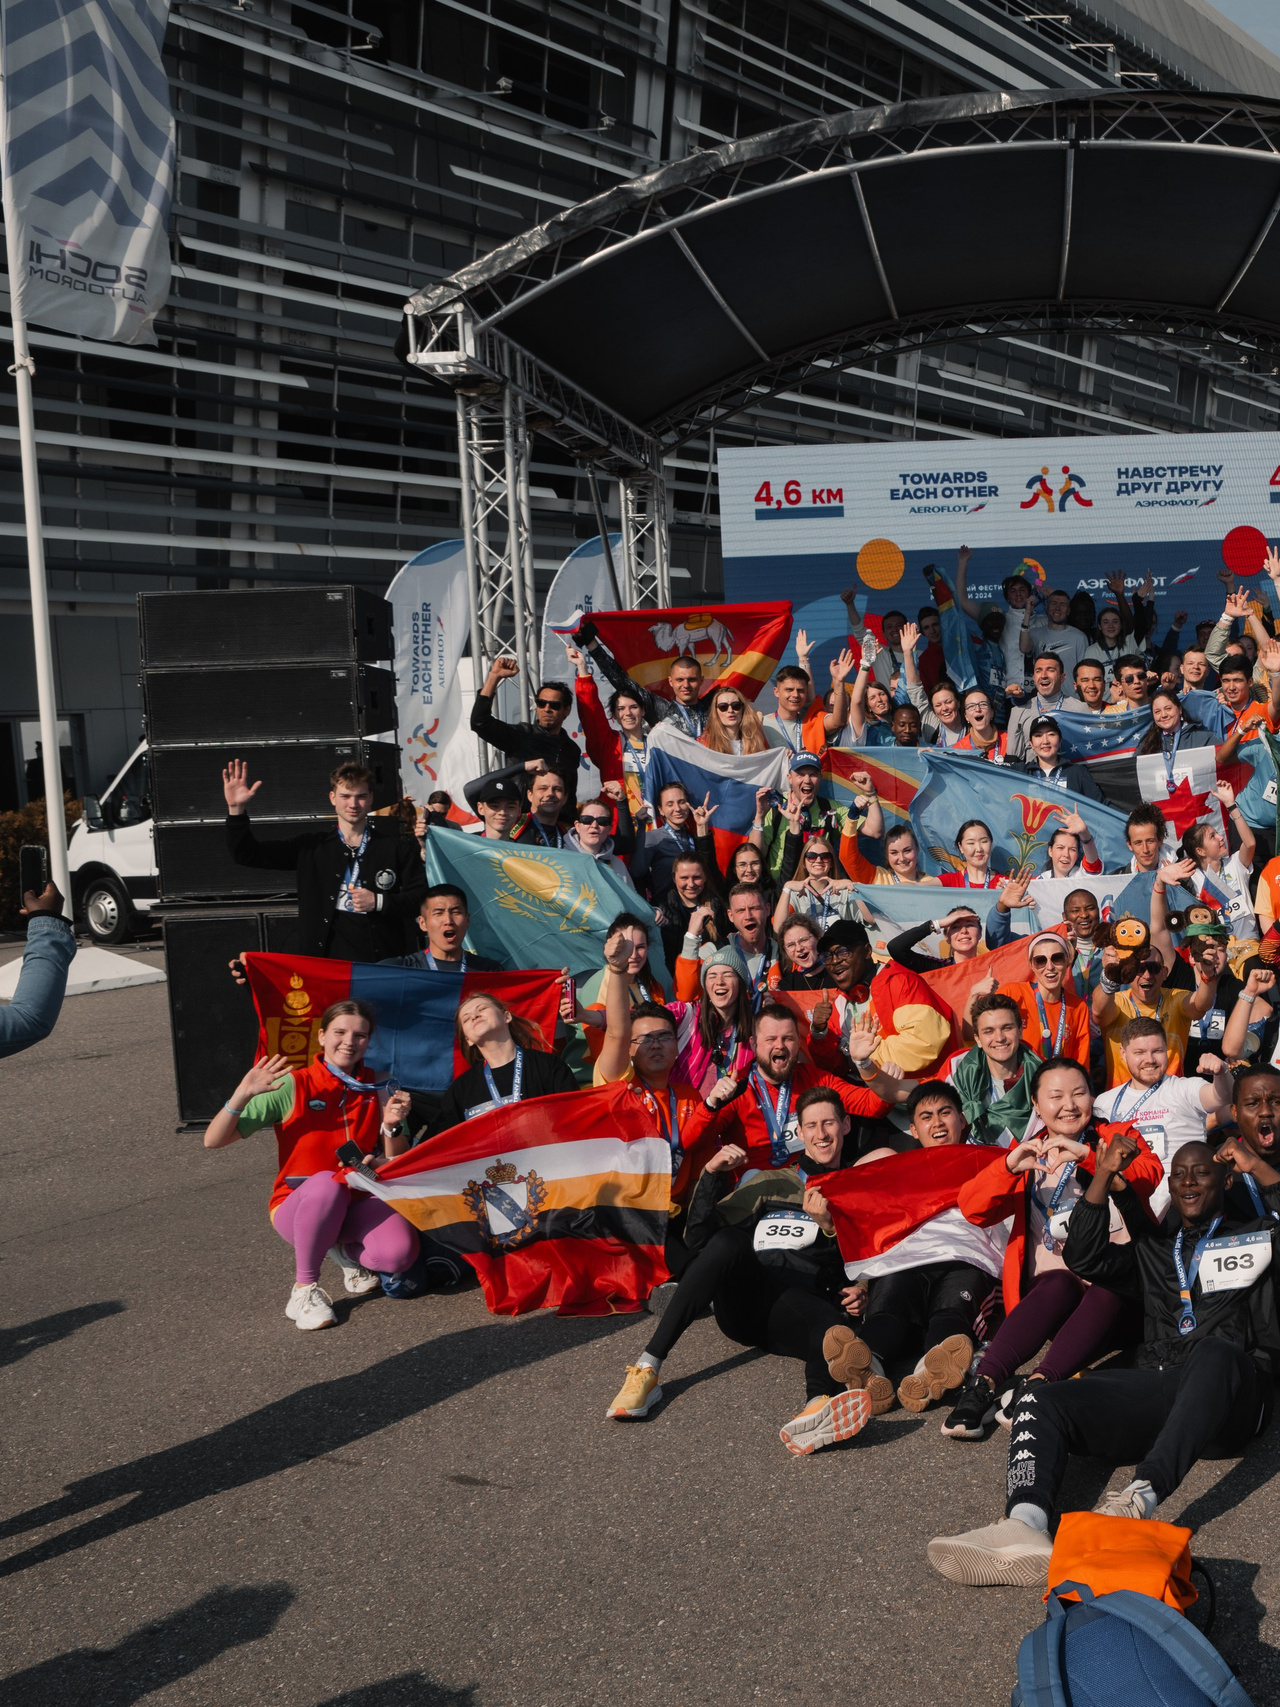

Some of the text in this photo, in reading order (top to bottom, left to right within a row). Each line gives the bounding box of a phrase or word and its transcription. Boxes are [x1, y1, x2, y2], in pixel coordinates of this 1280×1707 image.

[898, 471, 988, 486] TOWARDS
[1116, 465, 1224, 480] НАВСТРЕЧУ
[754, 480, 803, 511] 4,6
[890, 485, 999, 501] EACH OTHER
[1116, 480, 1224, 497] ДРУГ ДРУГУ
[909, 504, 969, 515] AEROFLOT
[1135, 498, 1200, 508] АЭРОФЛОТ
[410, 611, 421, 696] TOWARDS
[420, 602, 433, 706] EACH OTHER
[438, 632, 446, 688] AEROFLOT
[1139, 1108, 1170, 1117] КОМАНДА
[1139, 1114, 1164, 1122] КАЗАНИ
[1051, 1167, 1072, 1205] НАВСТРЕЧУ
[765, 1225, 805, 1238] 353
[1245, 1235, 1256, 1243] 4,6
[1213, 1252, 1255, 1273] 163
